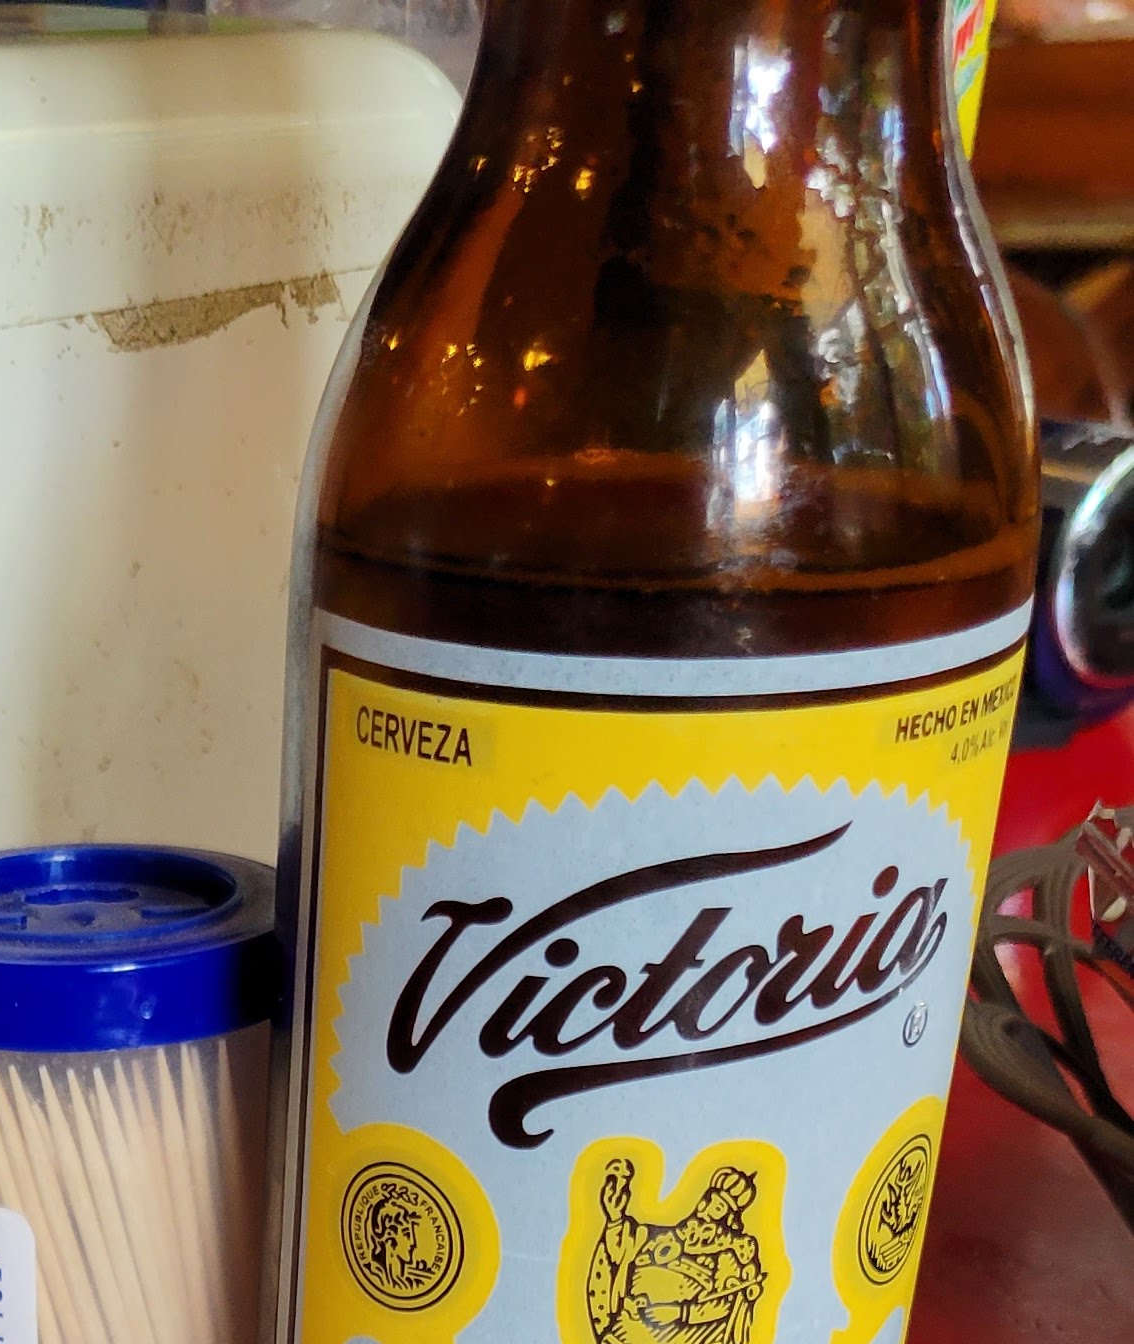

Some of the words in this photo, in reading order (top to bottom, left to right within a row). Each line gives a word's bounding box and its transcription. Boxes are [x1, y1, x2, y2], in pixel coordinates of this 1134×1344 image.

[356, 705, 472, 767] CERVEZA
[895, 704, 957, 743] HECHO
[959, 697, 980, 726] EN
[386, 820, 948, 1148] Victoria
